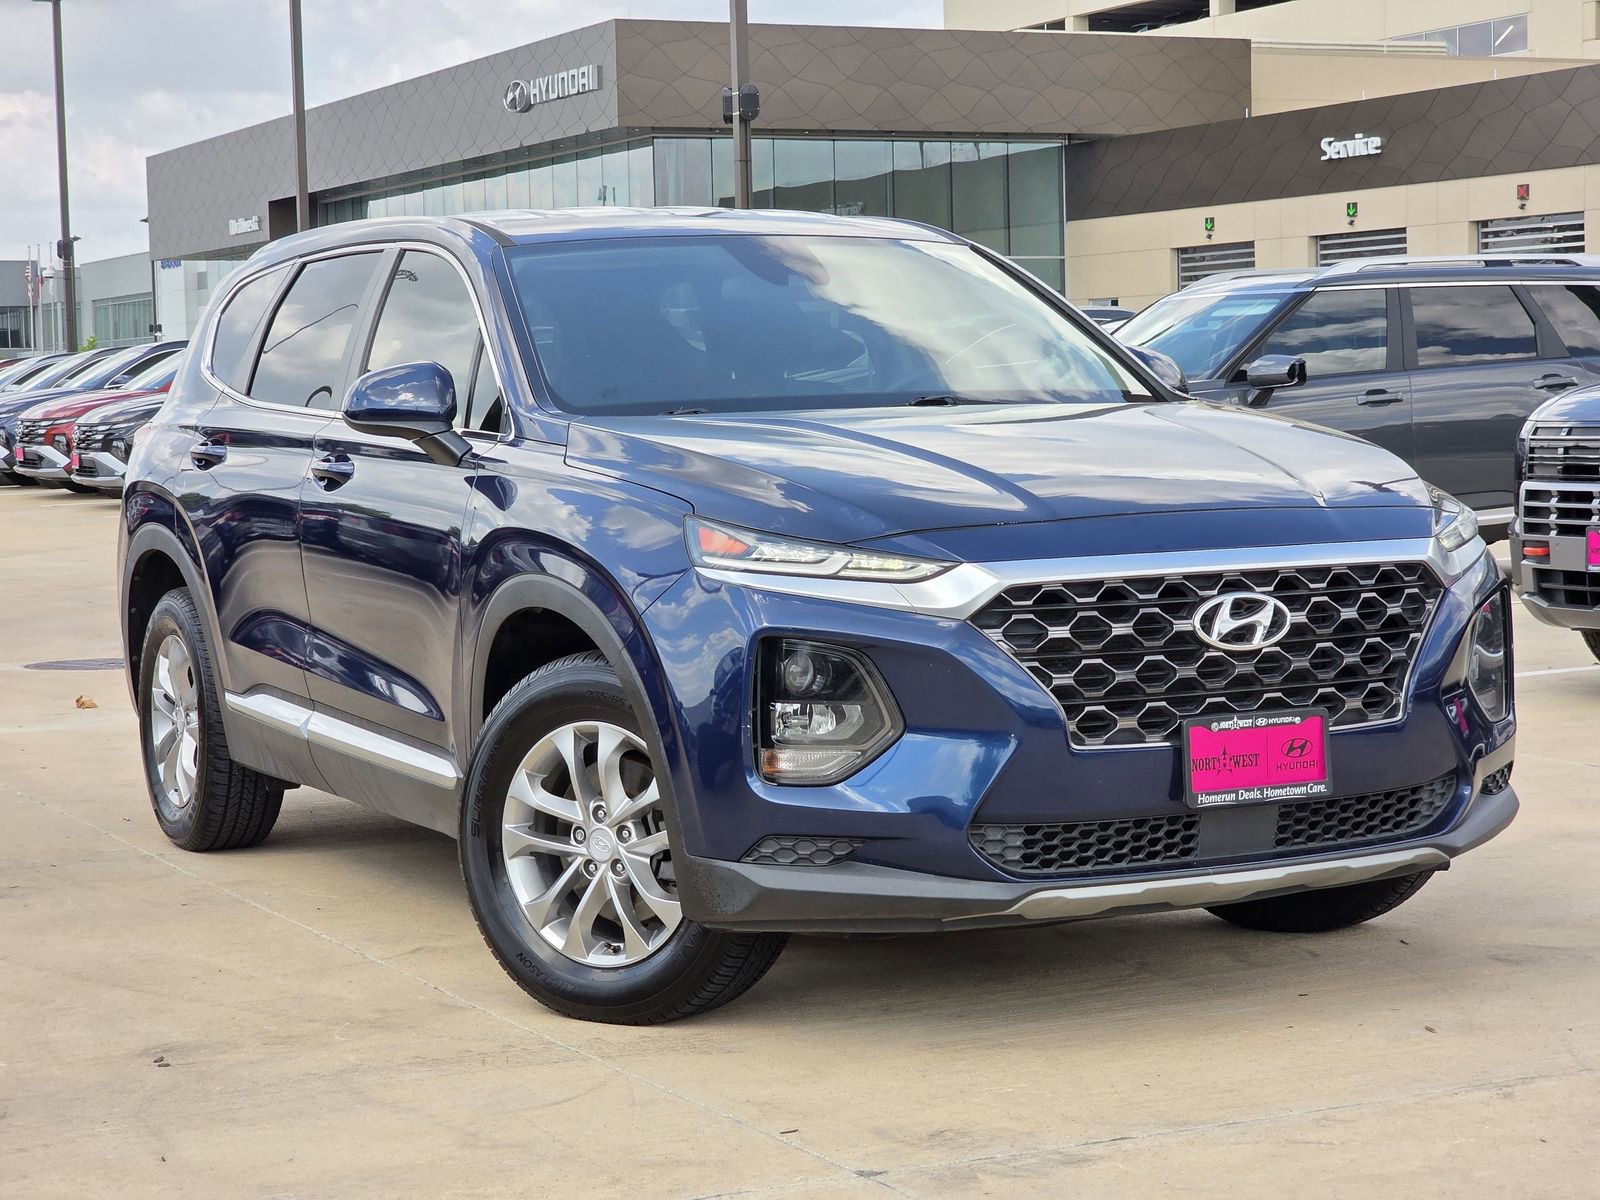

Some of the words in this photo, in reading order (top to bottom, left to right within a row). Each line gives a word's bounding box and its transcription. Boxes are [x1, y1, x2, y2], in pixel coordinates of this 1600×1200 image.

[530, 64, 598, 105] HYUNDAI
[1320, 133, 1382, 160] Service
[1276, 760, 1318, 771] HYUNDAI
[1197, 793, 1236, 804] Homerun
[1238, 787, 1262, 800] Deals.
[1263, 784, 1307, 798] Hometown
[1307, 783, 1327, 793] Care.
